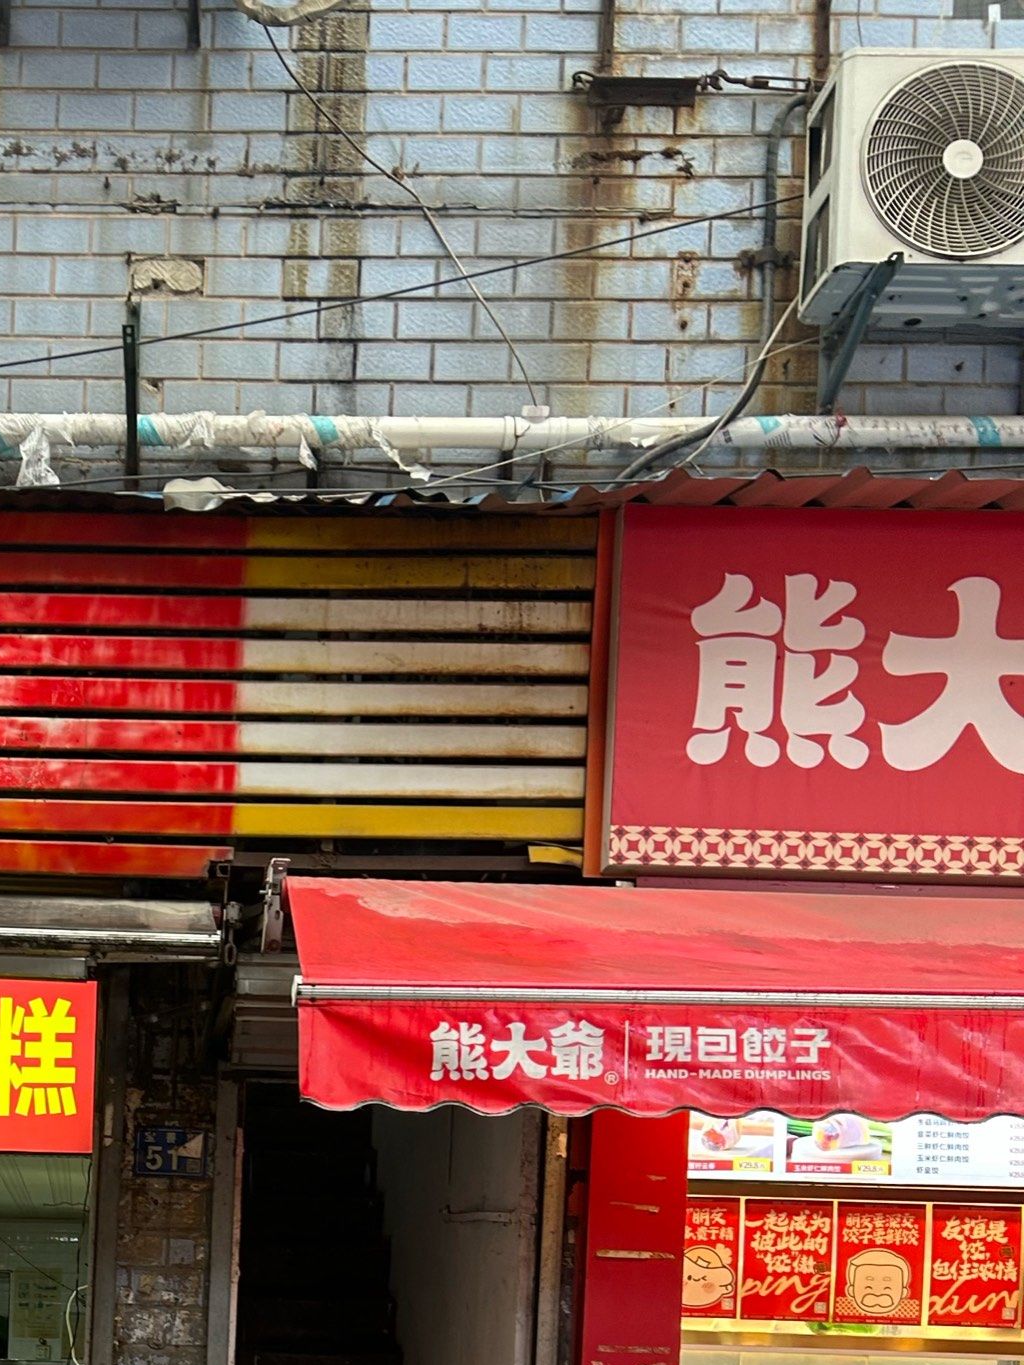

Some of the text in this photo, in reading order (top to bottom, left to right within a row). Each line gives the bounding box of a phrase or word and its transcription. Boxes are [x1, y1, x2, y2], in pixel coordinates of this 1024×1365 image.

[686, 572, 1024, 775] 熊大
[429, 1019, 832, 1082] 熊大爺 現包餃子
[645, 1068, 832, 1081] HAND-MADE DUMPLINGS
[145, 1146, 179, 1171] 51
[745, 1209, 831, 1234] 一起成为
[941, 1215, 1008, 1243] 友谊是
[750, 1230, 828, 1255] 彼此的
[932, 1259, 1018, 1282] 包住浓情
